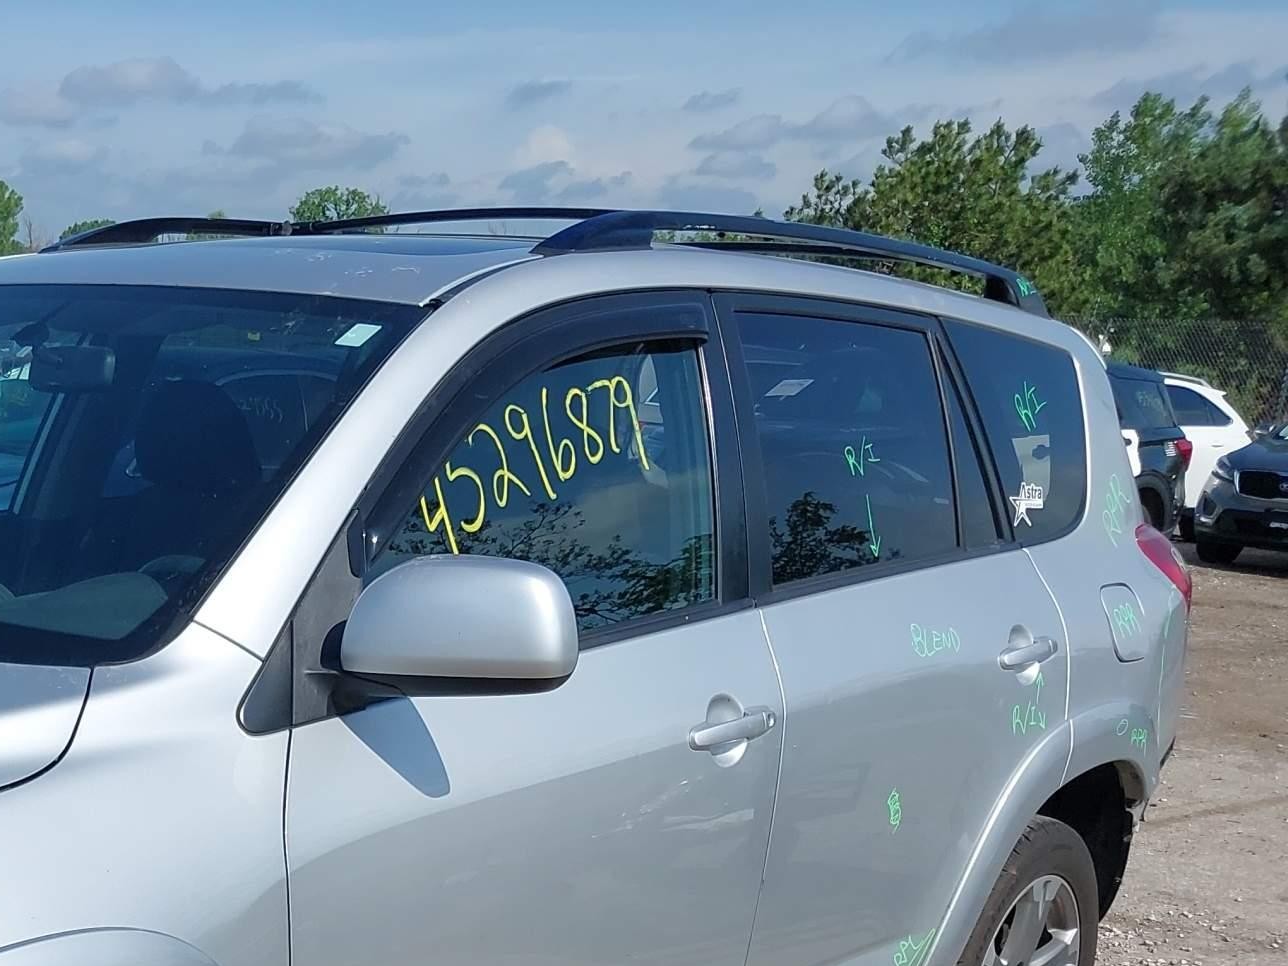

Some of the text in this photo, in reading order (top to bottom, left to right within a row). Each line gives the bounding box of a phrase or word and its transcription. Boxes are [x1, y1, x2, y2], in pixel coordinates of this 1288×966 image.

[420, 376, 649, 554] 45296879
[844, 436, 881, 476] R/I
[911, 623, 961, 657] BLEND
